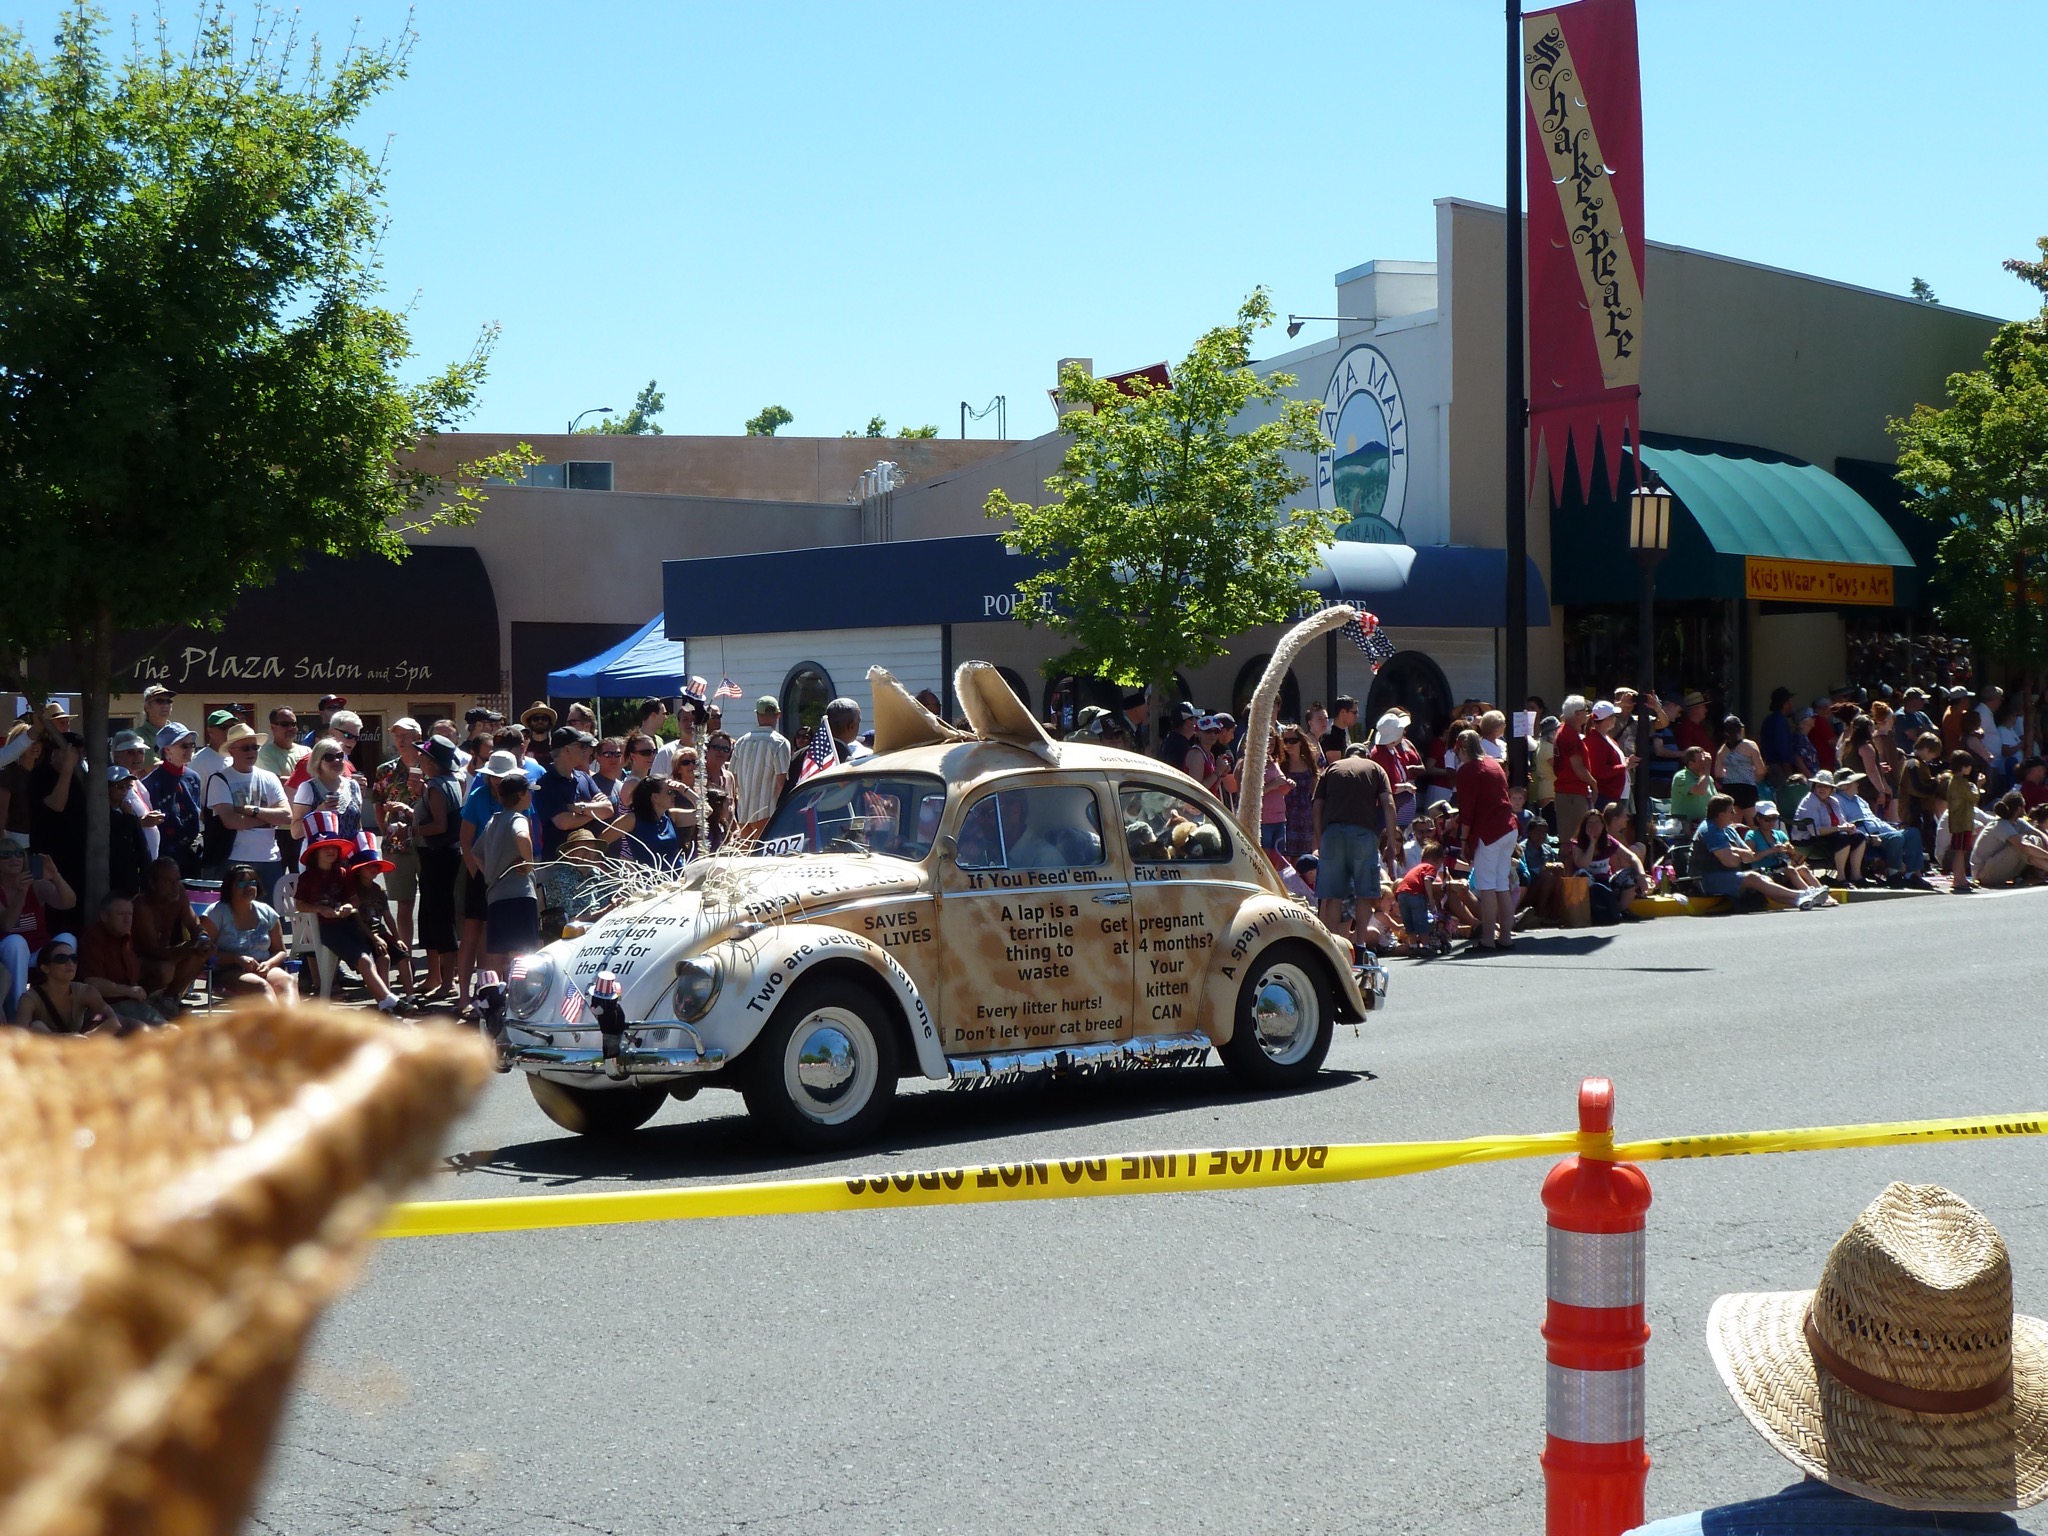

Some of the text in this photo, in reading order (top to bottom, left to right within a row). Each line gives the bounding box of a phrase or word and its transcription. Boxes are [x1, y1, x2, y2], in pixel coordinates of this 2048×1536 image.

[1525, 27, 1633, 360] Shakespeare
[1319, 356, 1405, 489] PLAZA MALL
[1341, 523, 1386, 543] SHLAND
[1751, 567, 1889, 596] Kids Wear Toys Art
[983, 591, 1054, 616] POLE
[133, 646, 433, 691] The Plaza Salon and Spa
[764, 836, 802, 856] 807
[968, 874, 984, 889] If
[989, 872, 1025, 888] You
[1134, 866, 1181, 881] Fix'em
[638, 914, 691, 928] aren't
[864, 911, 918, 930] SAVES
[1001, 903, 1079, 923] A lap is a
[1101, 911, 1204, 934] Get pregnant
[883, 928, 931, 947] LIVES
[1010, 922, 1074, 941] terrible
[577, 943, 651, 958] homes for
[1007, 942, 1074, 963] thing to
[1113, 932, 1214, 955] at 4 months?
[1221, 966, 1236, 981] A
[1231, 922, 1261, 962] spay
[1259, 911, 1278, 926] in
[611, 960, 635, 975] all
[1017, 963, 1070, 981] waste
[1150, 959, 1184, 974] Your
[746, 933, 932, 1039] Two are better than one
[1146, 979, 1189, 998] kitten
[977, 996, 1103, 1021] Every litter hurts!
[1152, 1004, 1182, 1020] CAN
[955, 1016, 1123, 1041] Don't let your cat breed
